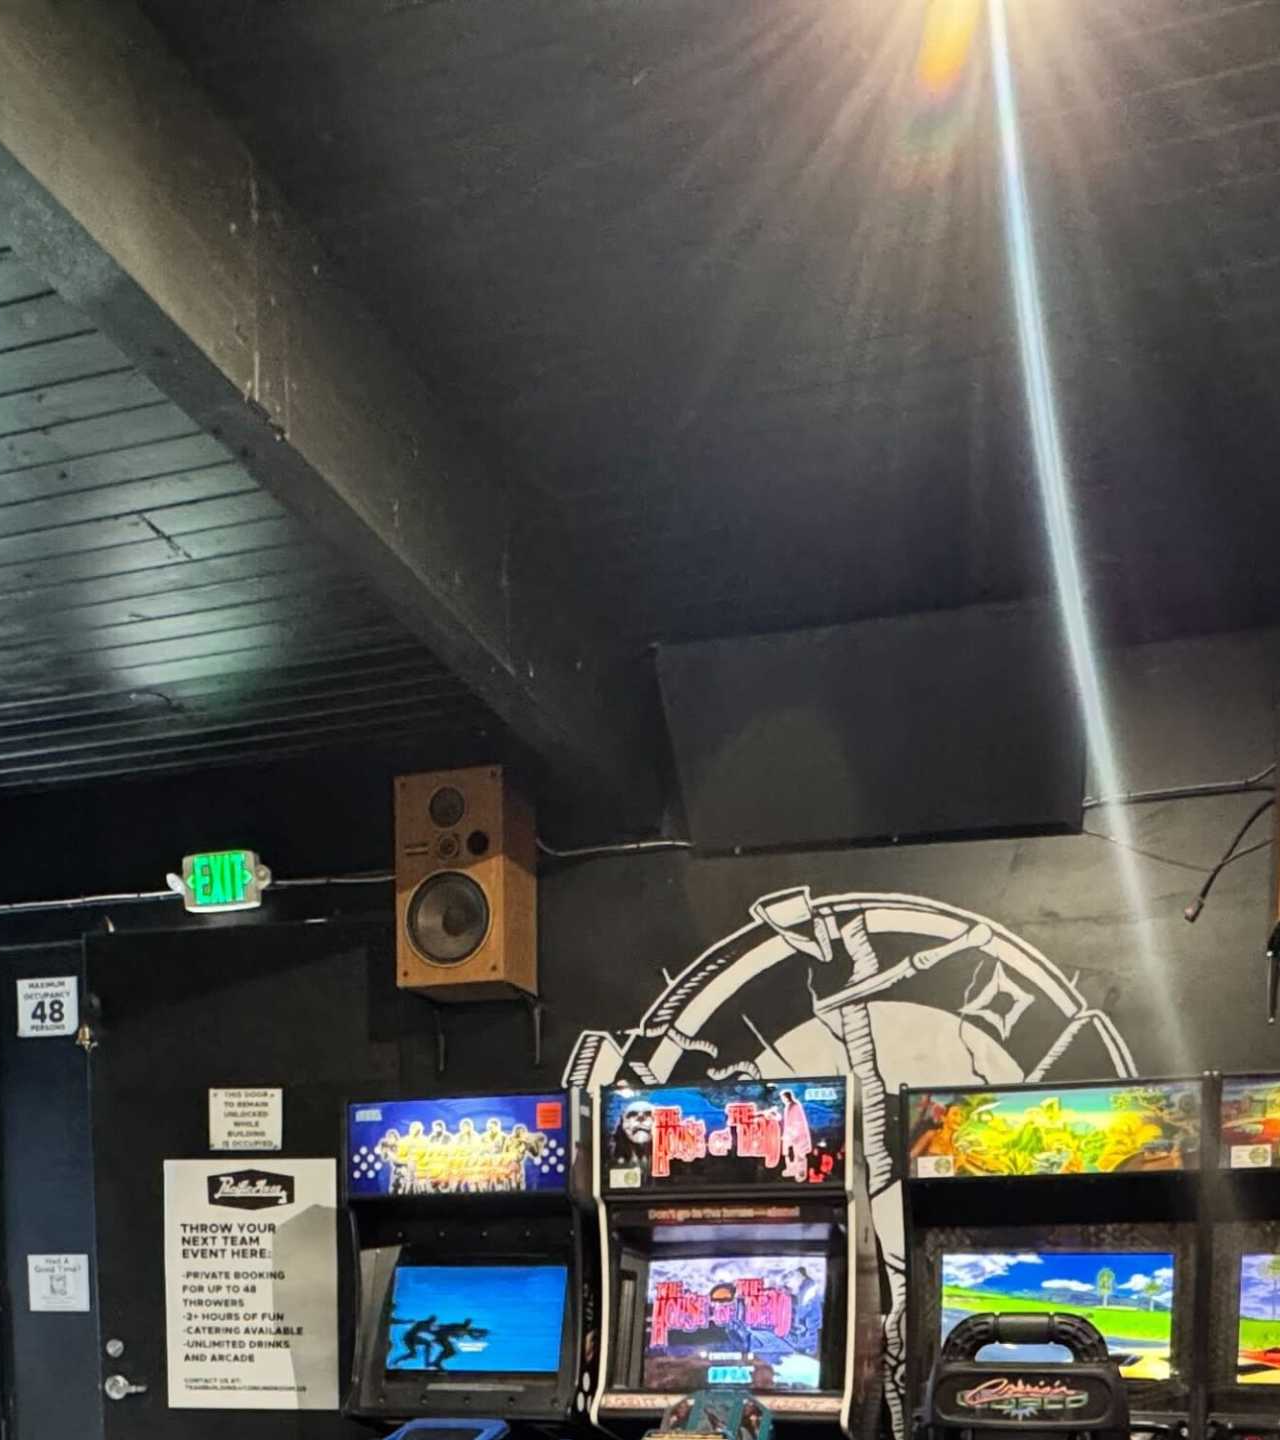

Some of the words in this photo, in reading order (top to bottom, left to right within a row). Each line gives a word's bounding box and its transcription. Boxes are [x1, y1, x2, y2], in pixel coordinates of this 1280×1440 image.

[195, 853, 245, 904] EXIT
[31, 1000, 64, 1023] 48
[181, 1223, 233, 1233] THROW
[237, 1223, 276, 1234] YOUR
[181, 1236, 218, 1246] NEXT
[221, 1236, 260, 1246] TEAM
[182, 1248, 227, 1259] EVENT
[231, 1248, 272, 1259] HERE:
[234, 1271, 285, 1280] BOOKING
[182, 1285, 204, 1294] FOR
[208, 1285, 222, 1294] UP
[226, 1285, 240, 1294] TO
[243, 1285, 257, 1294] 48
[182, 1298, 245, 1307] THROWERS
[202, 1312, 240, 1321] HOURS
[243, 1312, 258, 1321] OF
[261, 1312, 285, 1321] FUN
[243, 1326, 303, 1336] AVAILABLE
[249, 1340, 290, 1349] DRINKS
[184, 1354, 207, 1362] AND
[210, 1354, 255, 1362] ARCADE
